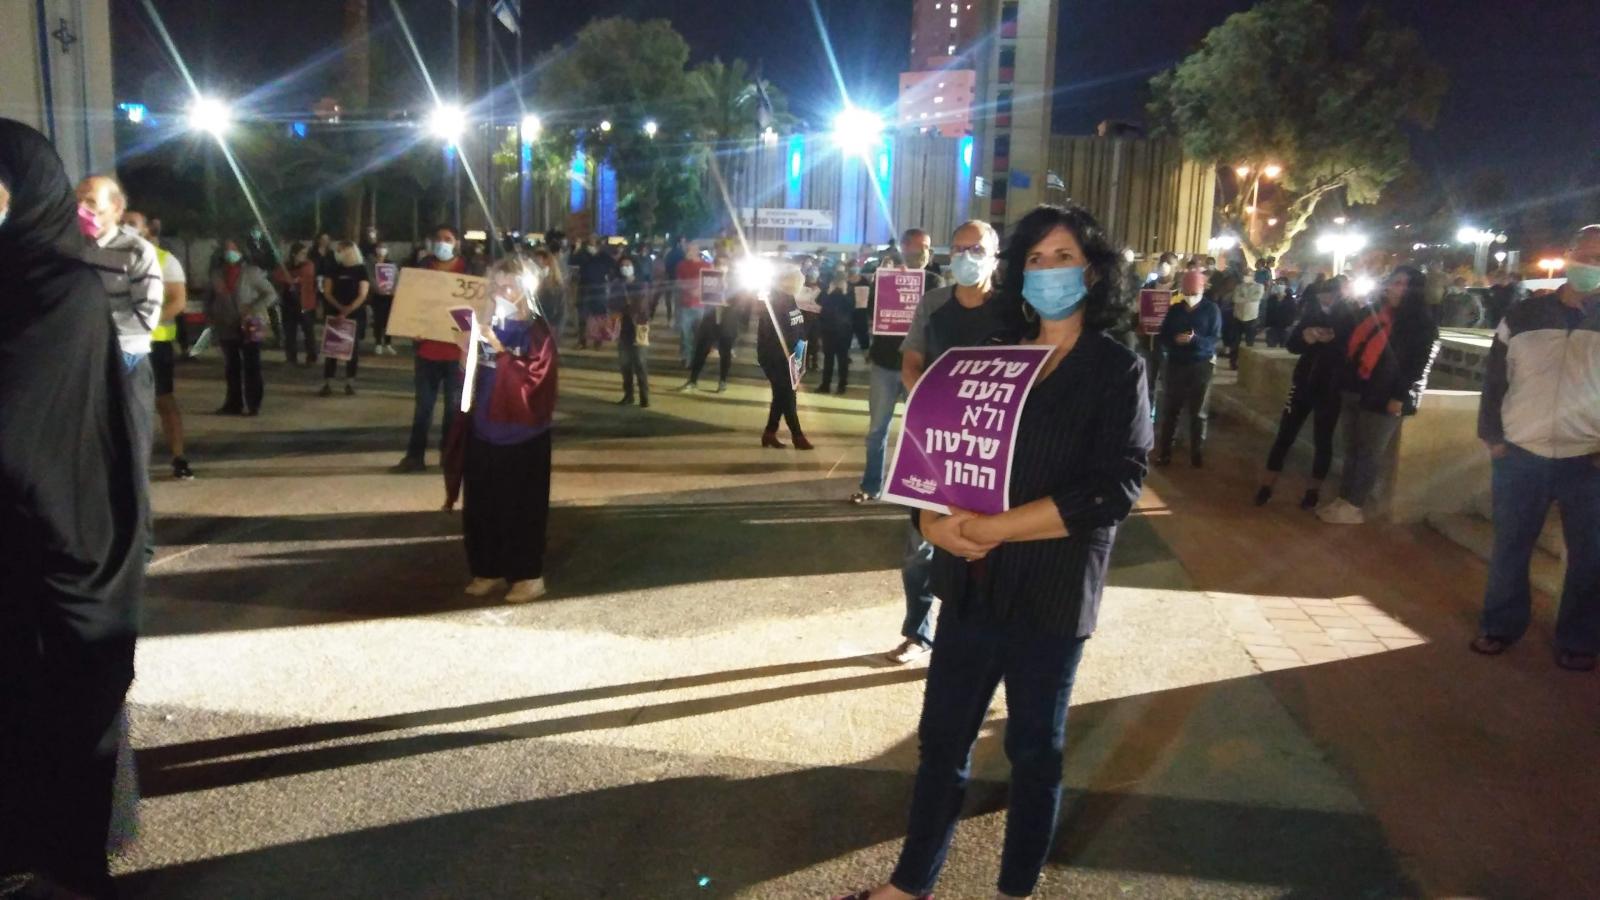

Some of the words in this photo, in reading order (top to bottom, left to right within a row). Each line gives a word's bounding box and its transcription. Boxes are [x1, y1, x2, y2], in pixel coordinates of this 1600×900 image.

[948, 357, 1030, 379] שלטון
[957, 379, 1016, 404] העם
[961, 402, 1006, 432] ולא
[925, 428, 1000, 460] שלטון
[944, 459, 996, 490] ההון
